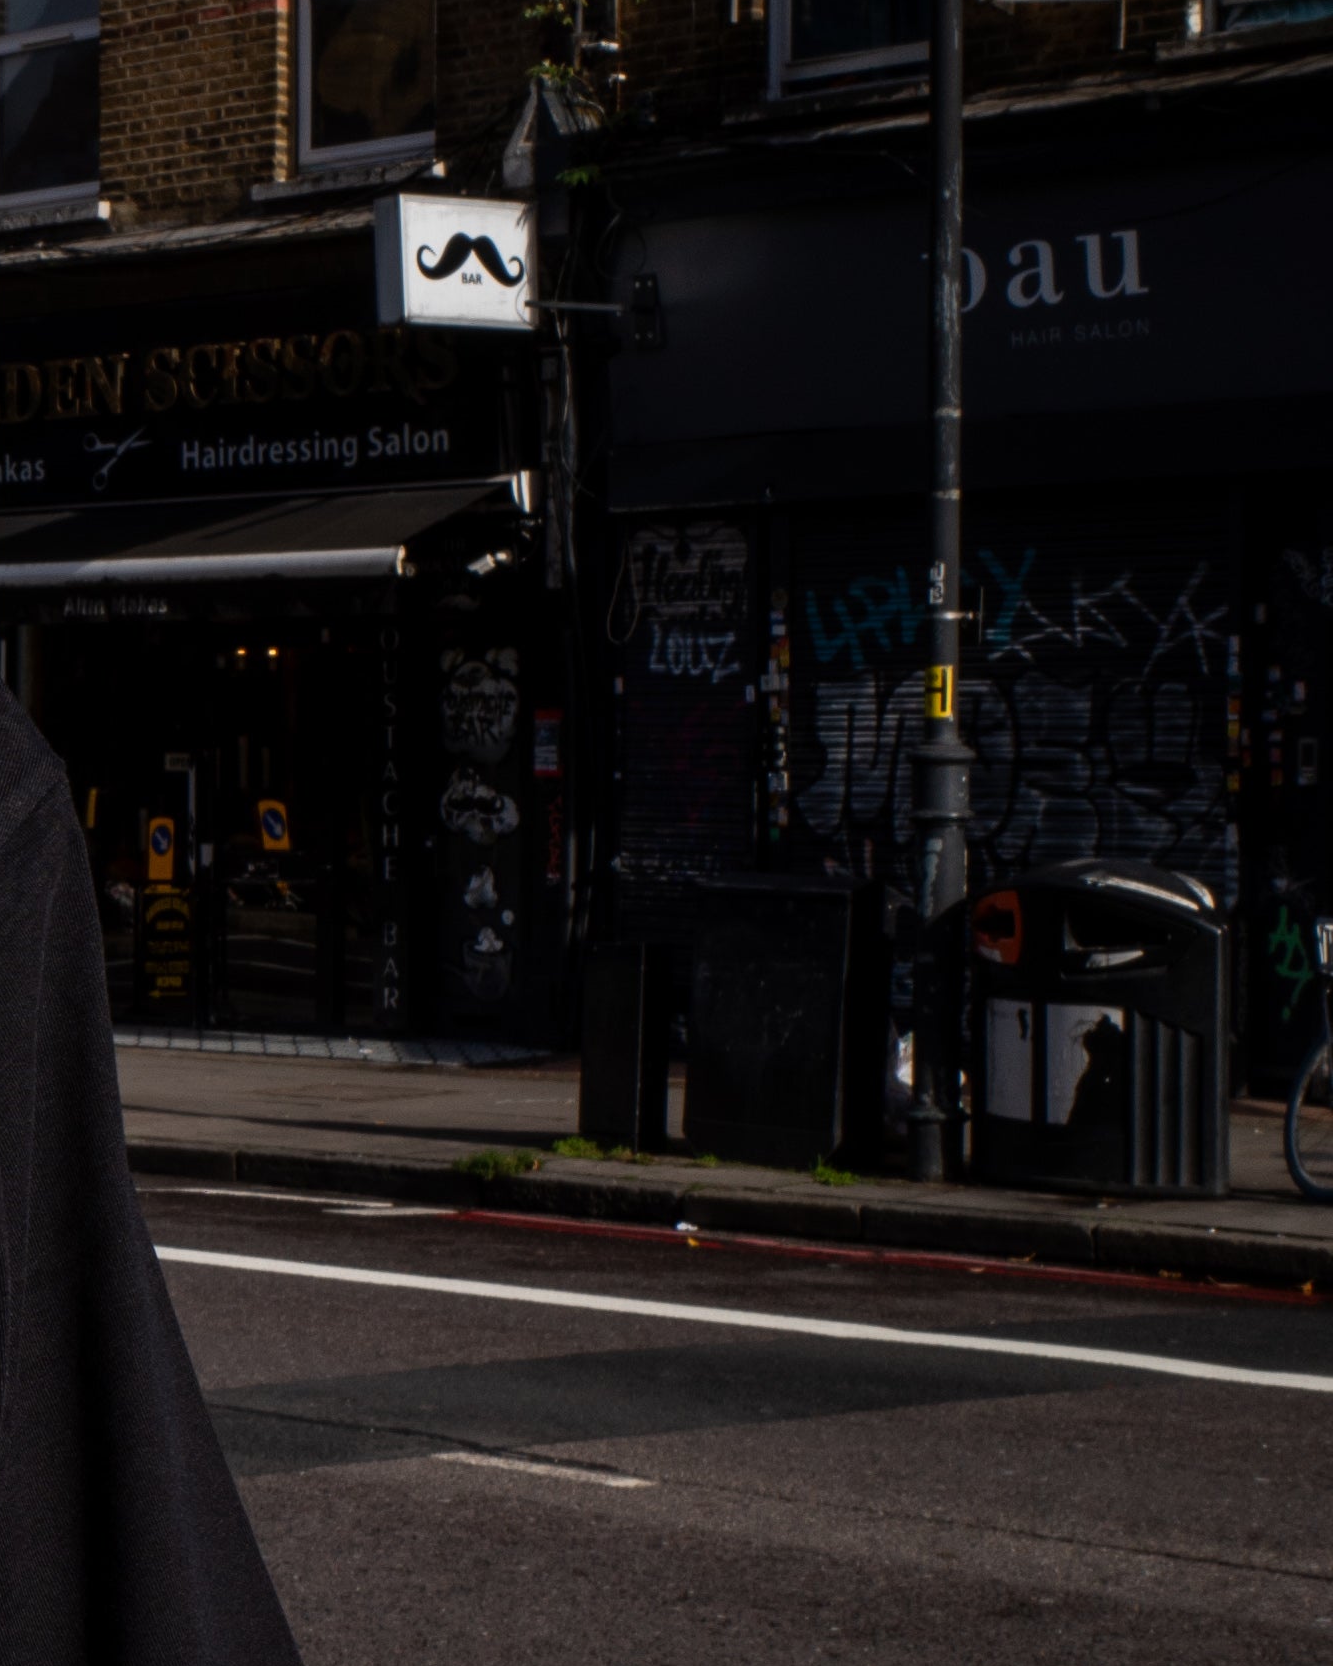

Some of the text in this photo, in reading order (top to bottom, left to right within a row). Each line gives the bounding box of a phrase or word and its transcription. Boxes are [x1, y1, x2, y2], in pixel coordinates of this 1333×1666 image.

[461, 272, 482, 284] BAR
[1010, 318, 1150, 349] HAIR SALON
[181, 421, 450, 470] Hairdressing Salon
